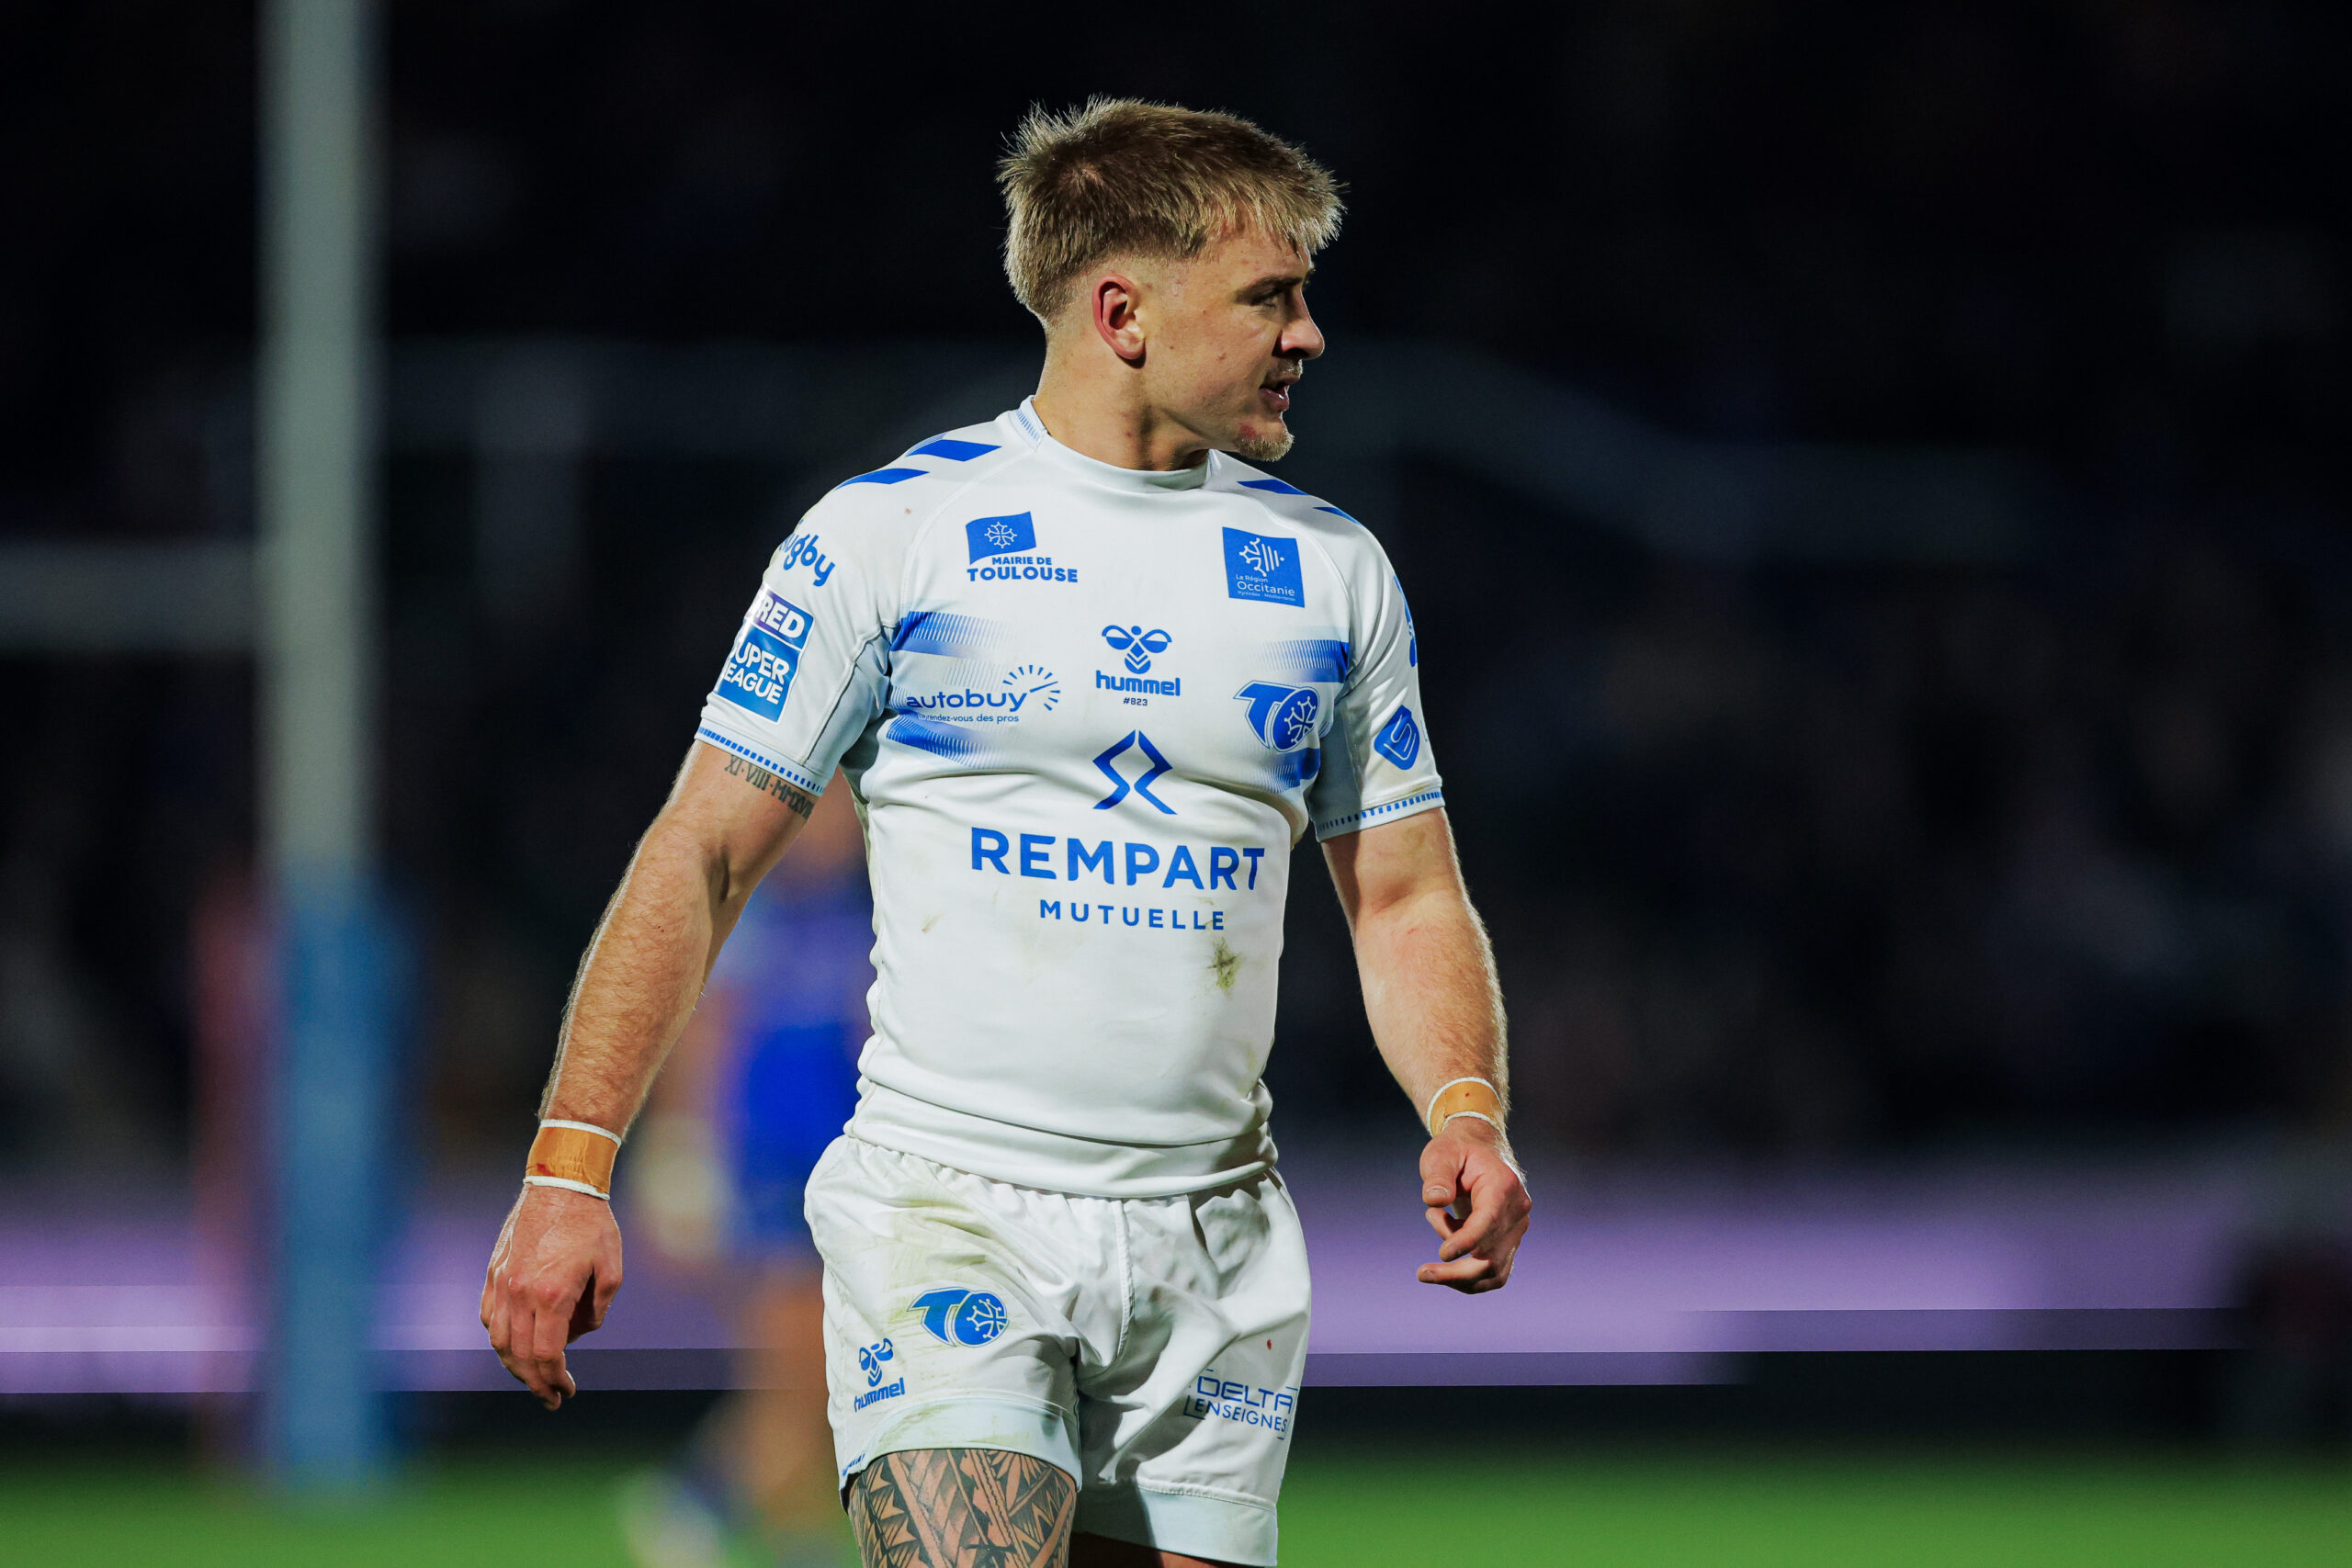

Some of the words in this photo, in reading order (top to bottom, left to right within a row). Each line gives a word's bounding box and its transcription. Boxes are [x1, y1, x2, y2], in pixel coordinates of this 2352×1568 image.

[967, 566, 1079, 583] TOULOUSE
[992, 556, 1034, 565] MAIRIE
[1035, 557, 1052, 566] DE
[1237, 581, 1295, 597] Occitanie
[732, 642, 790, 685] UPER
[723, 662, 784, 705] EAGUE
[1096, 670, 1181, 696] hummel
[906, 688, 1027, 712] autobuy
[976, 714, 994, 723] des
[997, 716, 1020, 725] pros
[971, 827, 1265, 891] REMPART
[1040, 899, 1224, 931] MUTUELLE
[854, 1377, 906, 1413] hummel
[1197, 1375, 1294, 1415] DELTA
[1194, 1397, 1287, 1433] ENSEIGNES
